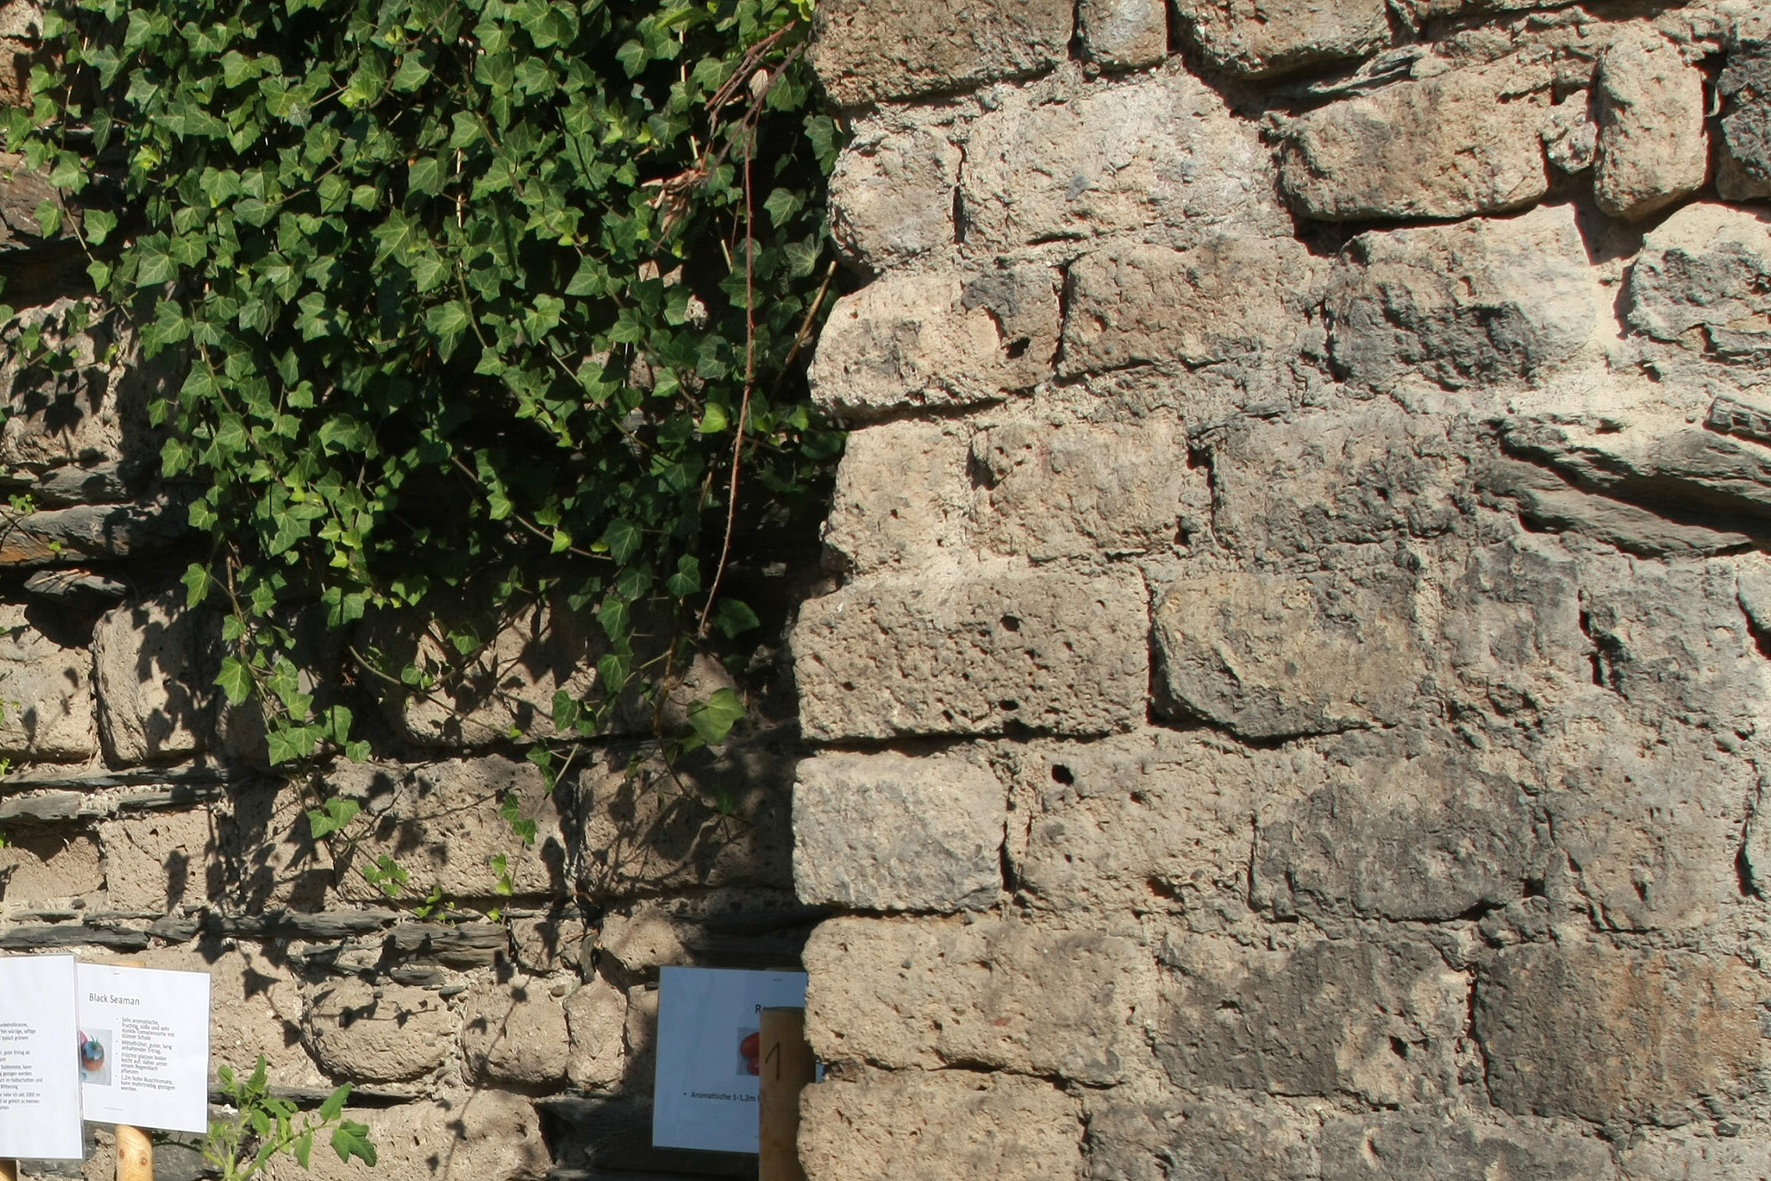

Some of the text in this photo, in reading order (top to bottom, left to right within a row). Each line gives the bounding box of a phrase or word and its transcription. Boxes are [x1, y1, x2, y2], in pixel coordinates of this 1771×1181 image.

[89, 992, 140, 1006] Black Seaman
[691, 1091, 731, 1101] Aromatische
[733, 1094, 756, 1102] 1-1,2m
